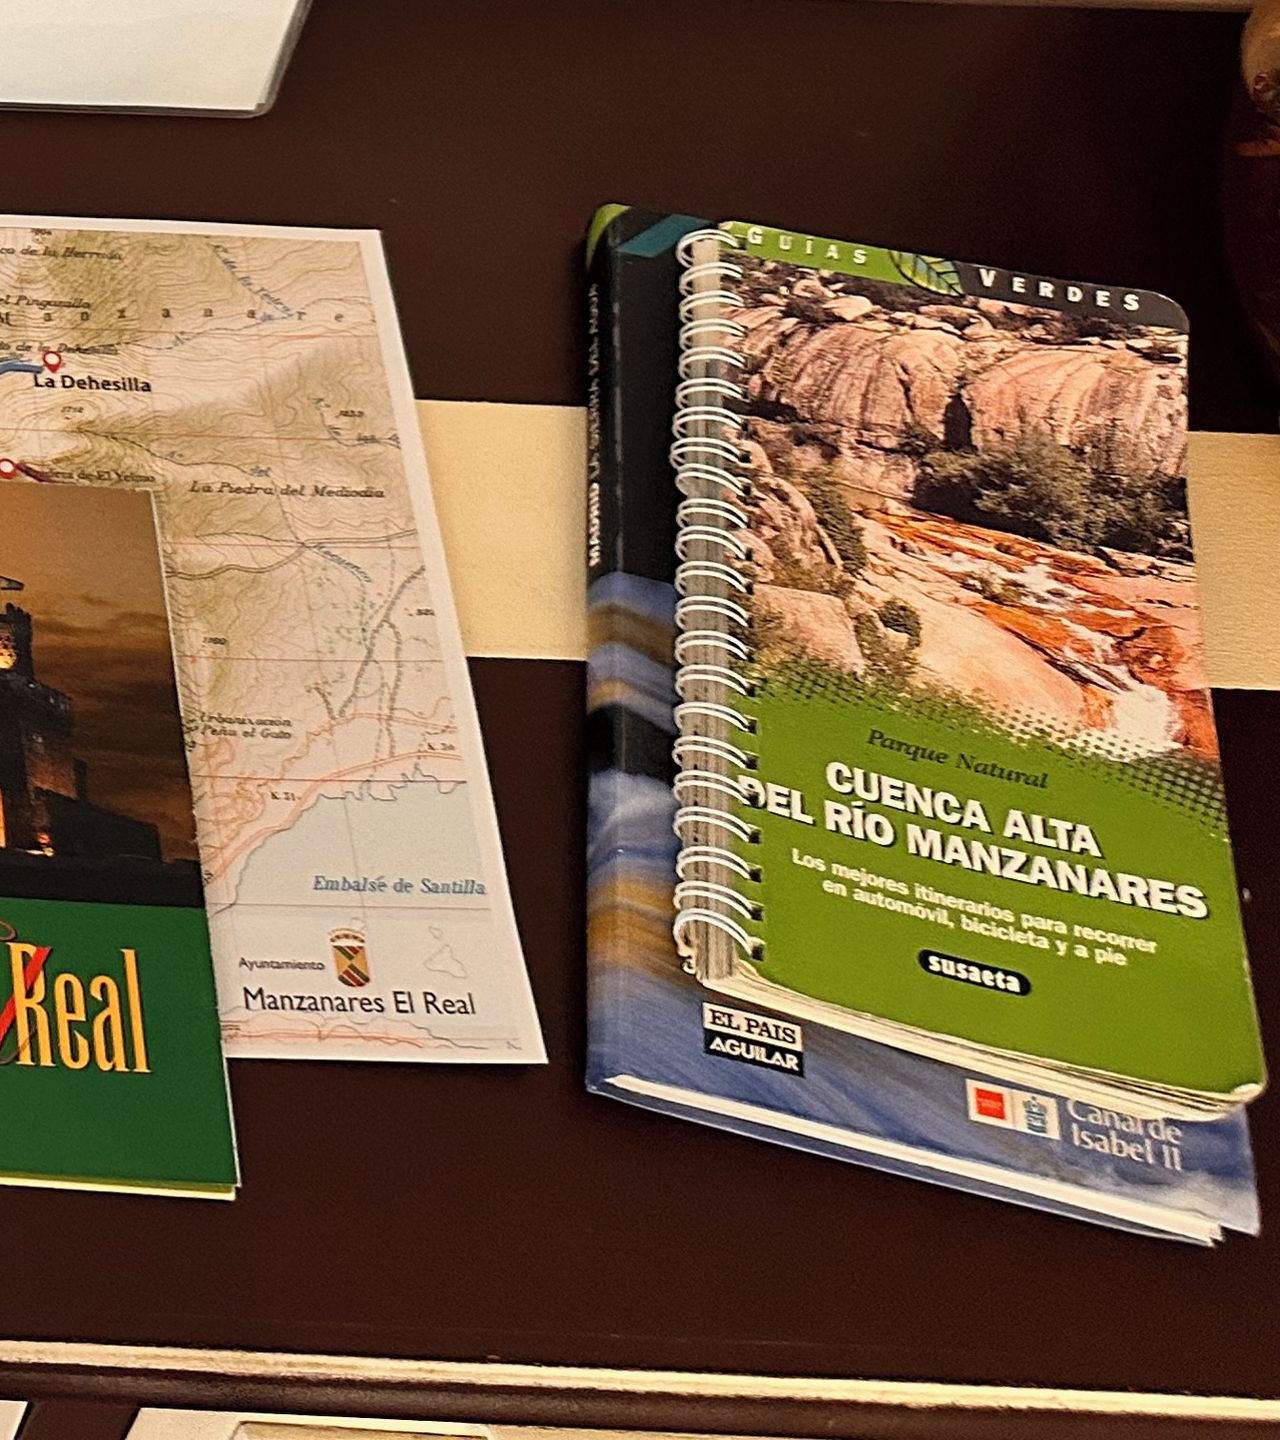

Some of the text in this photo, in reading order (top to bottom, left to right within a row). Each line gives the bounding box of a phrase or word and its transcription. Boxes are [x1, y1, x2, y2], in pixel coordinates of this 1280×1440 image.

[979, 268, 1141, 312] VERDES
[34, 374, 152, 393] La Dehesilla
[588, 482, 601, 567] MADRID
[867, 728, 1050, 790] Parque Natural
[826, 761, 1102, 858] CUENCA ALTA
[824, 794, 894, 848] RÍO
[907, 823, 1210, 921] MANZANARES
[387, 879, 414, 894] de
[420, 878, 487, 895] Santilla
[792, 847, 1158, 955] Los mejores itinerarios para recorrer
[822, 879, 1127, 967] en automóvil, bicicleta y a pie
[239, 957, 326, 971] Ayuntamiento
[927, 954, 1023, 994] susaeta
[7, 941, 152, 1074] Real
[243, 986, 477, 1015] Manzanares El Real
[708, 1008, 741, 1031] EL
[708, 1035, 800, 1072] AGUILAR
[1071, 1122, 1183, 1172] Isabel II
[1147, 1118, 1183, 1145] de
